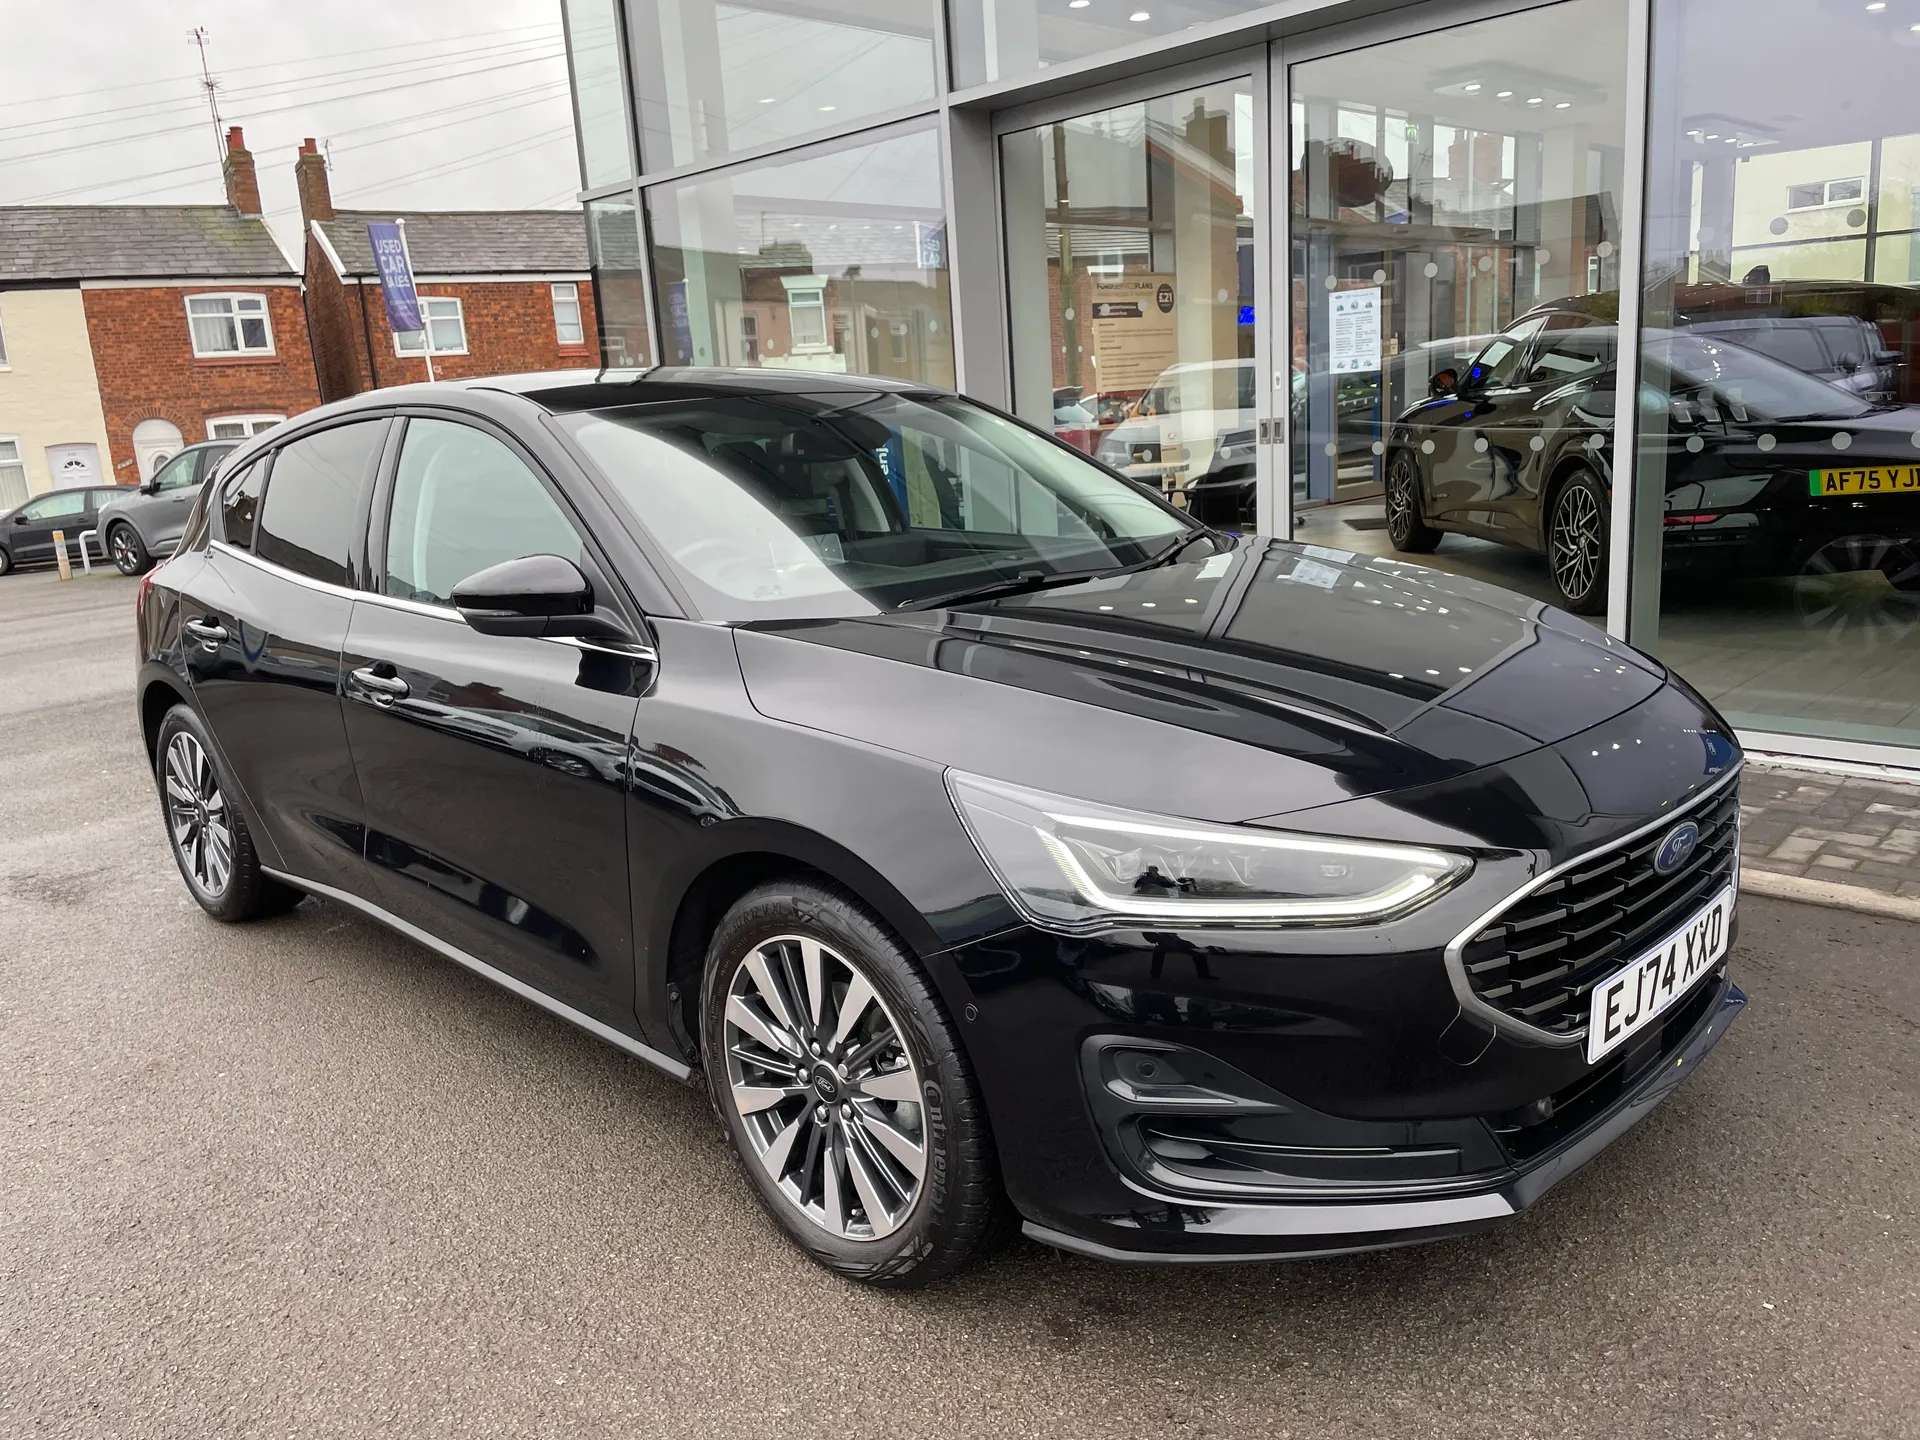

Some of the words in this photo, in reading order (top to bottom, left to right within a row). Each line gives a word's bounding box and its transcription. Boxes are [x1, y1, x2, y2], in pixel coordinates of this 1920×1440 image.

[375, 239, 402, 254] USED
[381, 255, 406, 274] CAR
[1825, 470, 1881, 491] AF75
[1604, 943, 1676, 1044] EJ74
[1682, 904, 1723, 984] XXD
